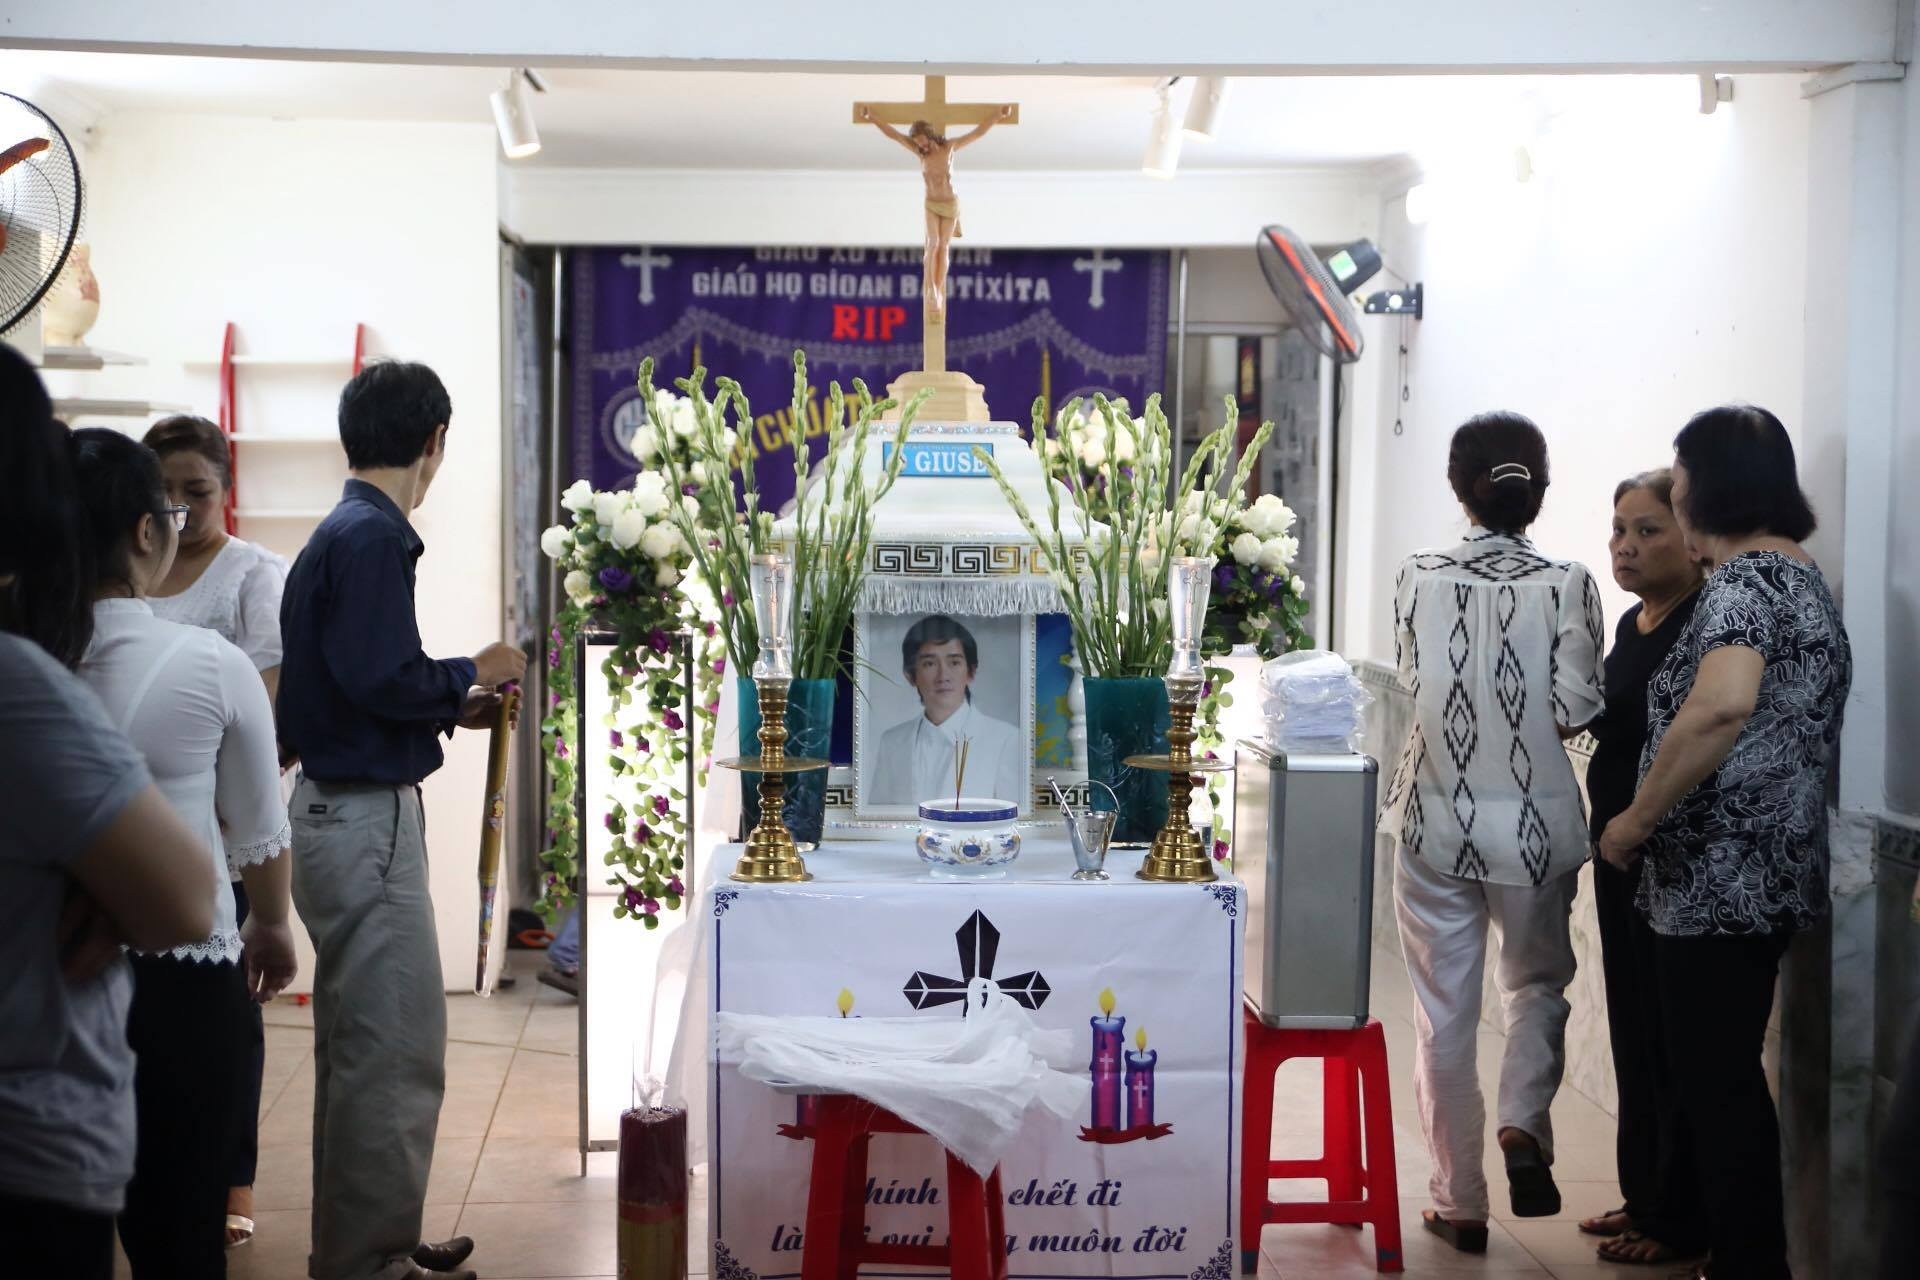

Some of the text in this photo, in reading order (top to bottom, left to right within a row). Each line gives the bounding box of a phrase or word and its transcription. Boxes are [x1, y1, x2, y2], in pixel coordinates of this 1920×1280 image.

[765, 272, 803, 302] HỌ
[832, 304, 906, 341] RIP
[865, 1177, 1122, 1207] hính chết đi
[771, 1224, 804, 1252] là
[1028, 1228, 1124, 1253] muôn
[1133, 1225, 1188, 1253] đời
